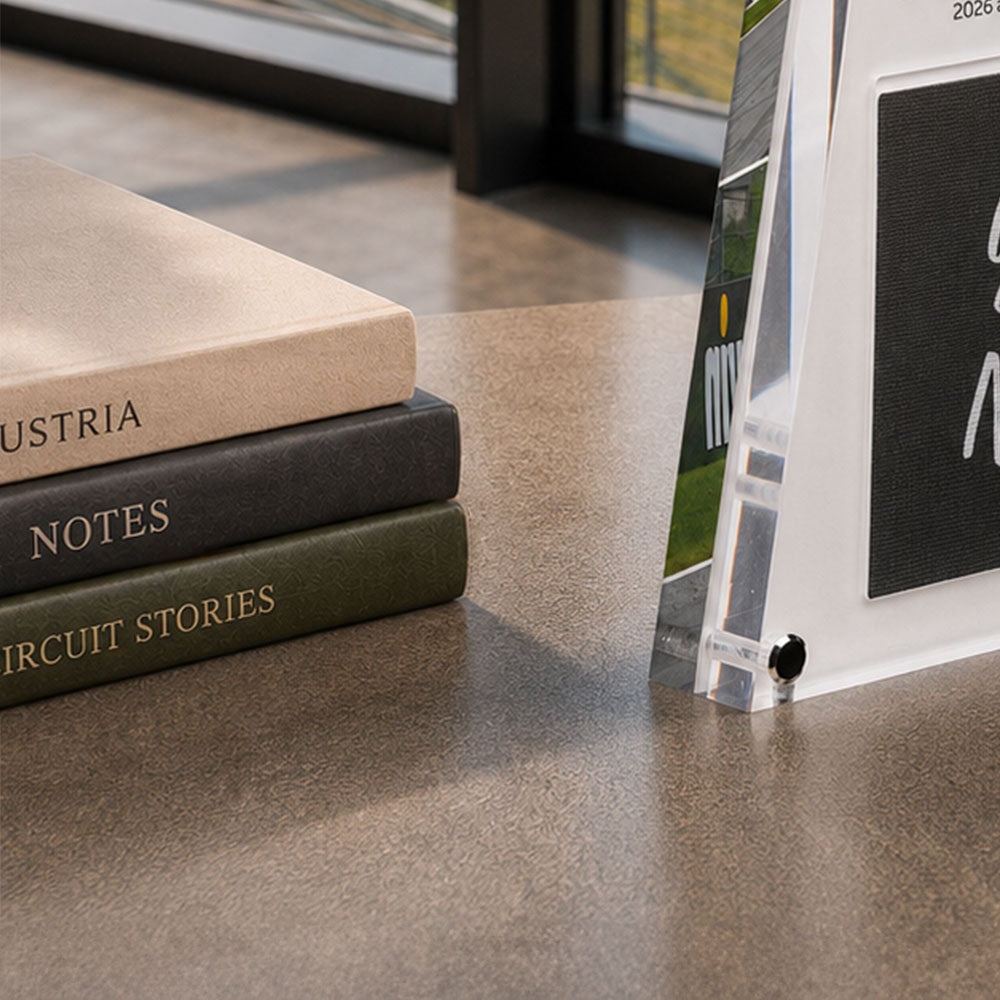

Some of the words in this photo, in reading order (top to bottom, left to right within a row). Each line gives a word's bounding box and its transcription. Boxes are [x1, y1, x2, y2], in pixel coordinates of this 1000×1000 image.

[0, 400, 141, 453] USTRIA
[30, 498, 170, 559] NOTES
[0, 619, 124, 676] IRCUIT
[136, 585, 275, 643] STORIES
